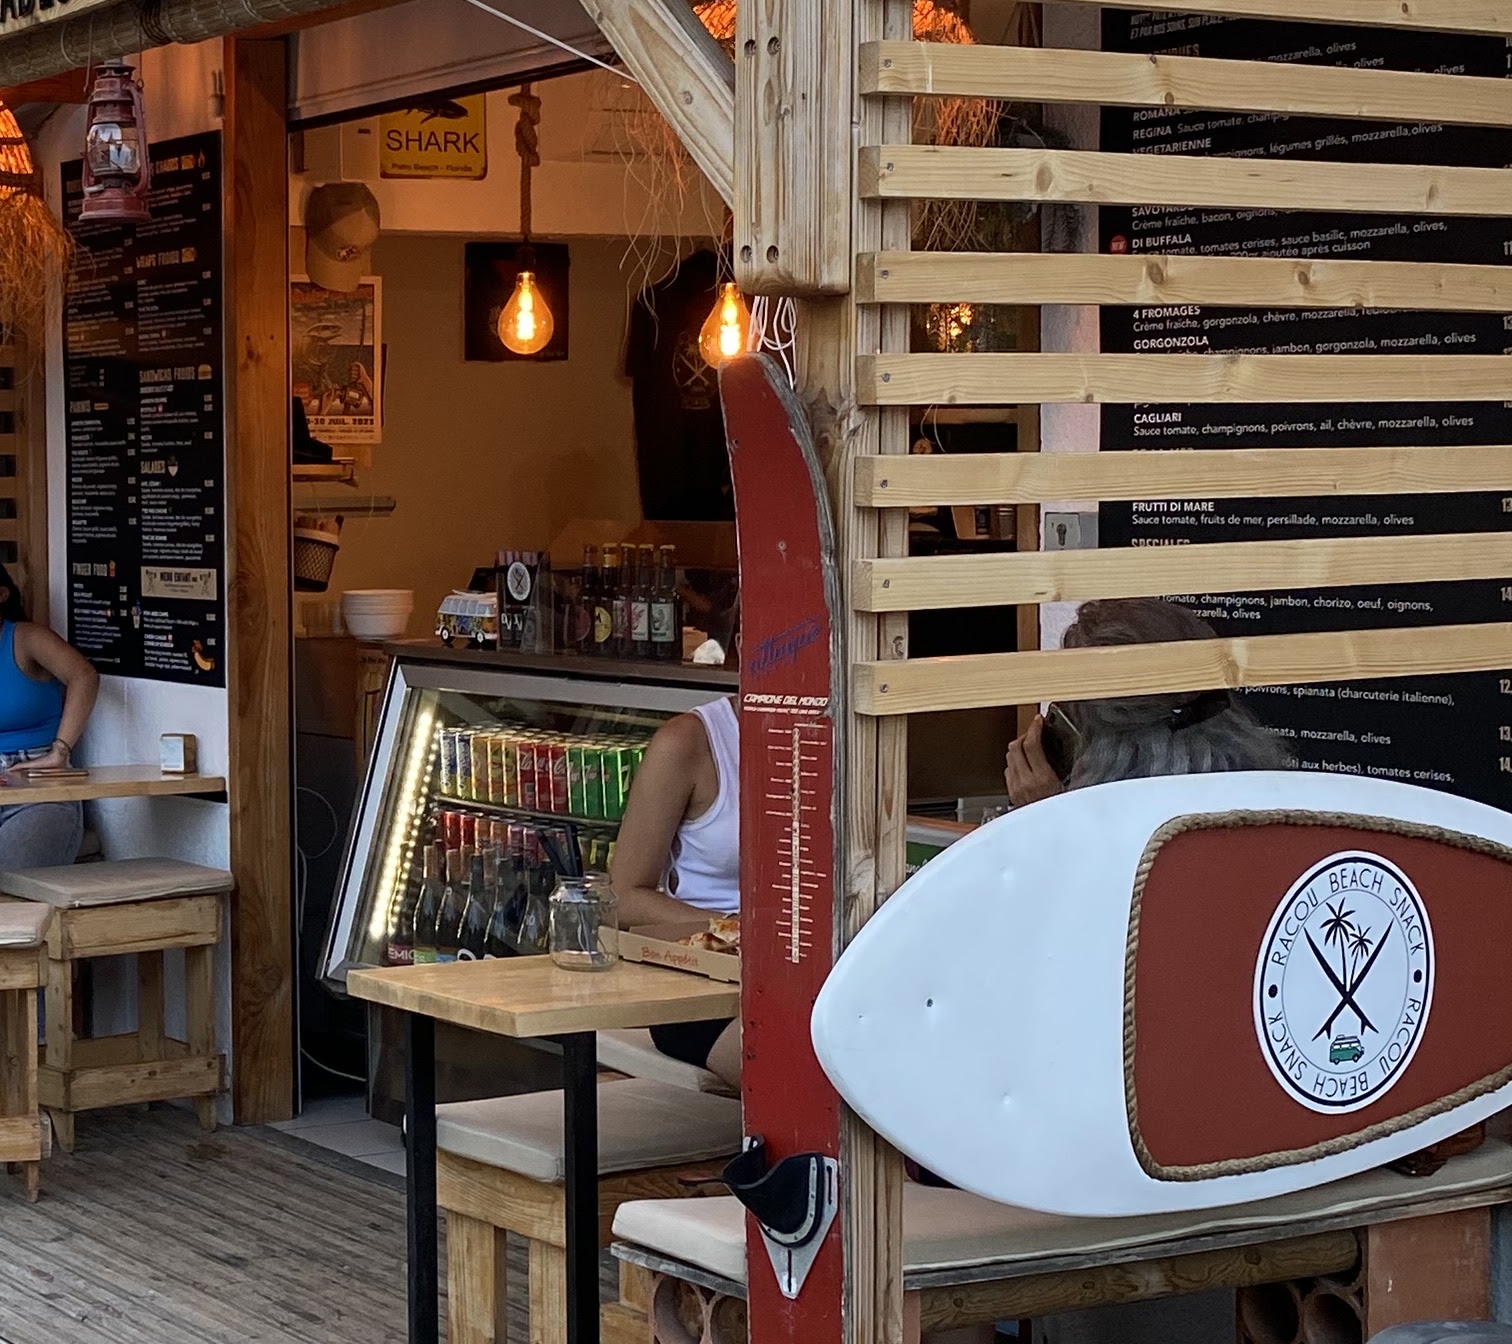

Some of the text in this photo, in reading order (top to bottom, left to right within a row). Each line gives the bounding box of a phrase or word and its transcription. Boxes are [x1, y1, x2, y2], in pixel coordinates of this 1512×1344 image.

[1326, 41, 1357, 54] olives
[1133, 107, 1181, 122] ROMANA
[1133, 125, 1173, 140] REGINA
[386, 129, 480, 153] SHARK
[1133, 137, 1212, 155] VEGETARIENNE
[1269, 134, 1350, 156] légumes grillés,
[1132, 218, 1163, 231] Crème
[1201, 212, 1234, 224] bacon,
[1132, 238, 1144, 249] DI
[1145, 234, 1193, 247] BUFFALA
[1200, 242, 1240, 254] tomates
[1281, 233, 1310, 245] sauce
[1350, 223, 1410, 239] mozzarella,
[1412, 221, 1448, 233] olives,
[1301, 244, 1330, 257] après
[1331, 241, 1371, 253] cuisson
[1132, 305, 1201, 319] 4 FROMAGES
[1133, 320, 1164, 332] Crème
[1202, 315, 1261, 330] gorgonzola,
[1133, 336, 1209, 350] GORGONZOLA
[1315, 337, 1378, 354] gorgonzola,
[1380, 334, 1442, 349] mozzarella,
[1444, 332, 1477, 344] olives
[1133, 412, 1182, 424] CAGLIARI
[1133, 415, 1474, 436] Sauce tomate, champignons, poivrons, ail, chèvre, mozzarella, olives
[1132, 501, 1215, 512] FRUTTI DI MARE
[1132, 514, 1415, 528] Sauce tomate, fruits de mer, persillade, mozzarella, olives
[1200, 594, 1268, 607] champignons,
[1269, 595, 1311, 609] jambon,
[1313, 596, 1355, 609] chorizo,
[1387, 599, 1434, 613] oignons,
[1192, 608, 1261, 620] zzarella, olives
[783, 695, 799, 705] DEL
[798, 697, 828, 707] MONDO
[1293, 686, 1336, 699] spianata
[1337, 687, 1400, 702] (charcuterie
[1401, 690, 1455, 706] italienne),
[1300, 730, 1391, 745] mozzarella, olives
[1301, 759, 1455, 783] aux herbes), tomates cerises,
[1271, 867, 1424, 966] RACOU BEACH SNACK
[1268, 997, 1422, 1098] RACOU BEACH SNACK
